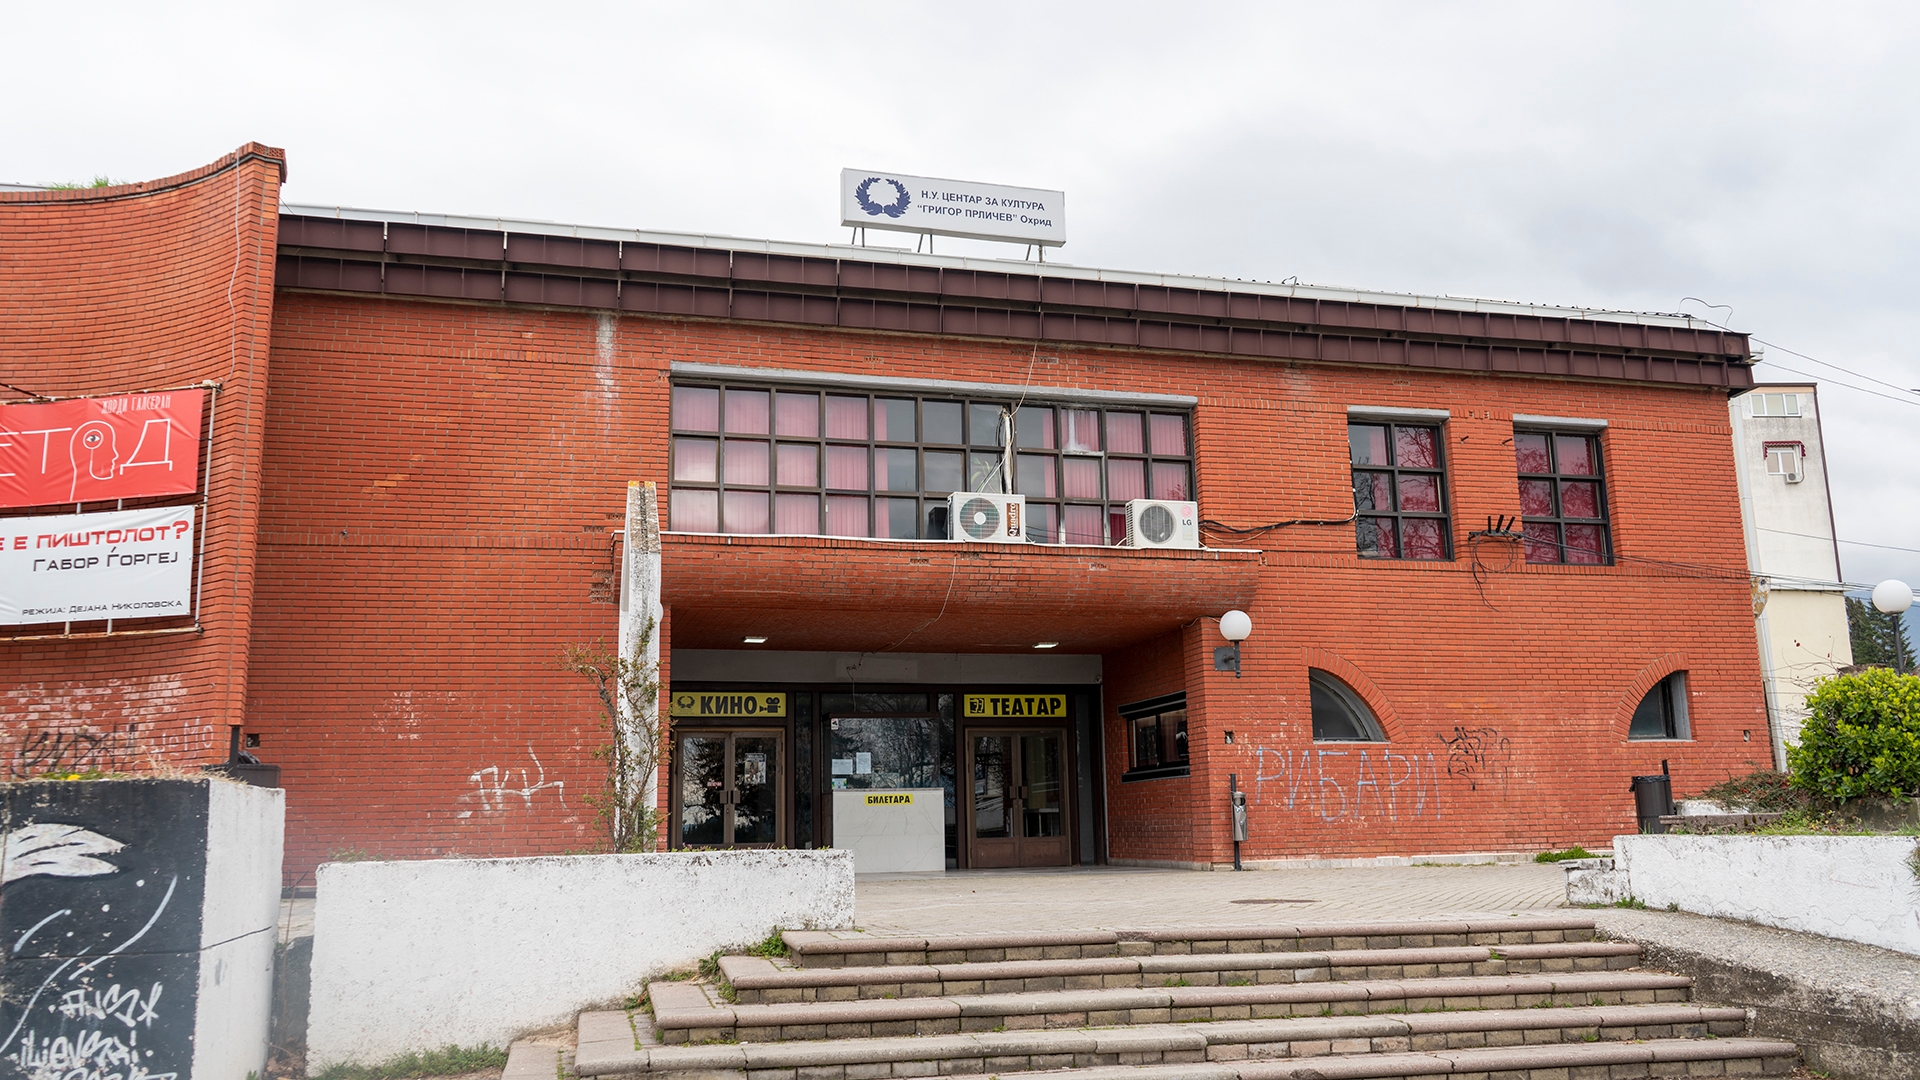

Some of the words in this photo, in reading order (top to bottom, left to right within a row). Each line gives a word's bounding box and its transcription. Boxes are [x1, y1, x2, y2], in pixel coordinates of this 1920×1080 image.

[921, 190, 939, 200] Н.У.
[942, 192, 982, 205] ЦЕНТАР
[985, 196, 998, 206] ЗА
[1001, 198, 1045, 211] КУЛТУРА
[917, 204, 962, 217] “ГРИГОР
[965, 209, 1018, 223] ПРЛИЧЕВ”
[1020, 214, 1052, 227] Охрид
[101, 396, 128, 414] ЖОРДИ
[131, 394, 171, 411] ГАЛСЕРАН
[1008, 502, 1018, 537] Quadro
[13, 536, 28, 550] Е
[36, 520, 189, 549] ПИШТОЛОТ?
[33, 557, 99, 572] ГАБОР
[107, 546, 178, 567] ЃОРГЕЈ
[22, 606, 66, 616] РЕЖИЈА:
[68, 604, 108, 614] ДЕЈАНА
[111, 600, 183, 611] НИКОЛОВСКА
[700, 695, 757, 714] КИНО
[990, 698, 1061, 715] ТЕАТАР
[1256, 746, 1441, 822] РИБАРИ
[867, 795, 911, 804] БИЛЕТАРА
